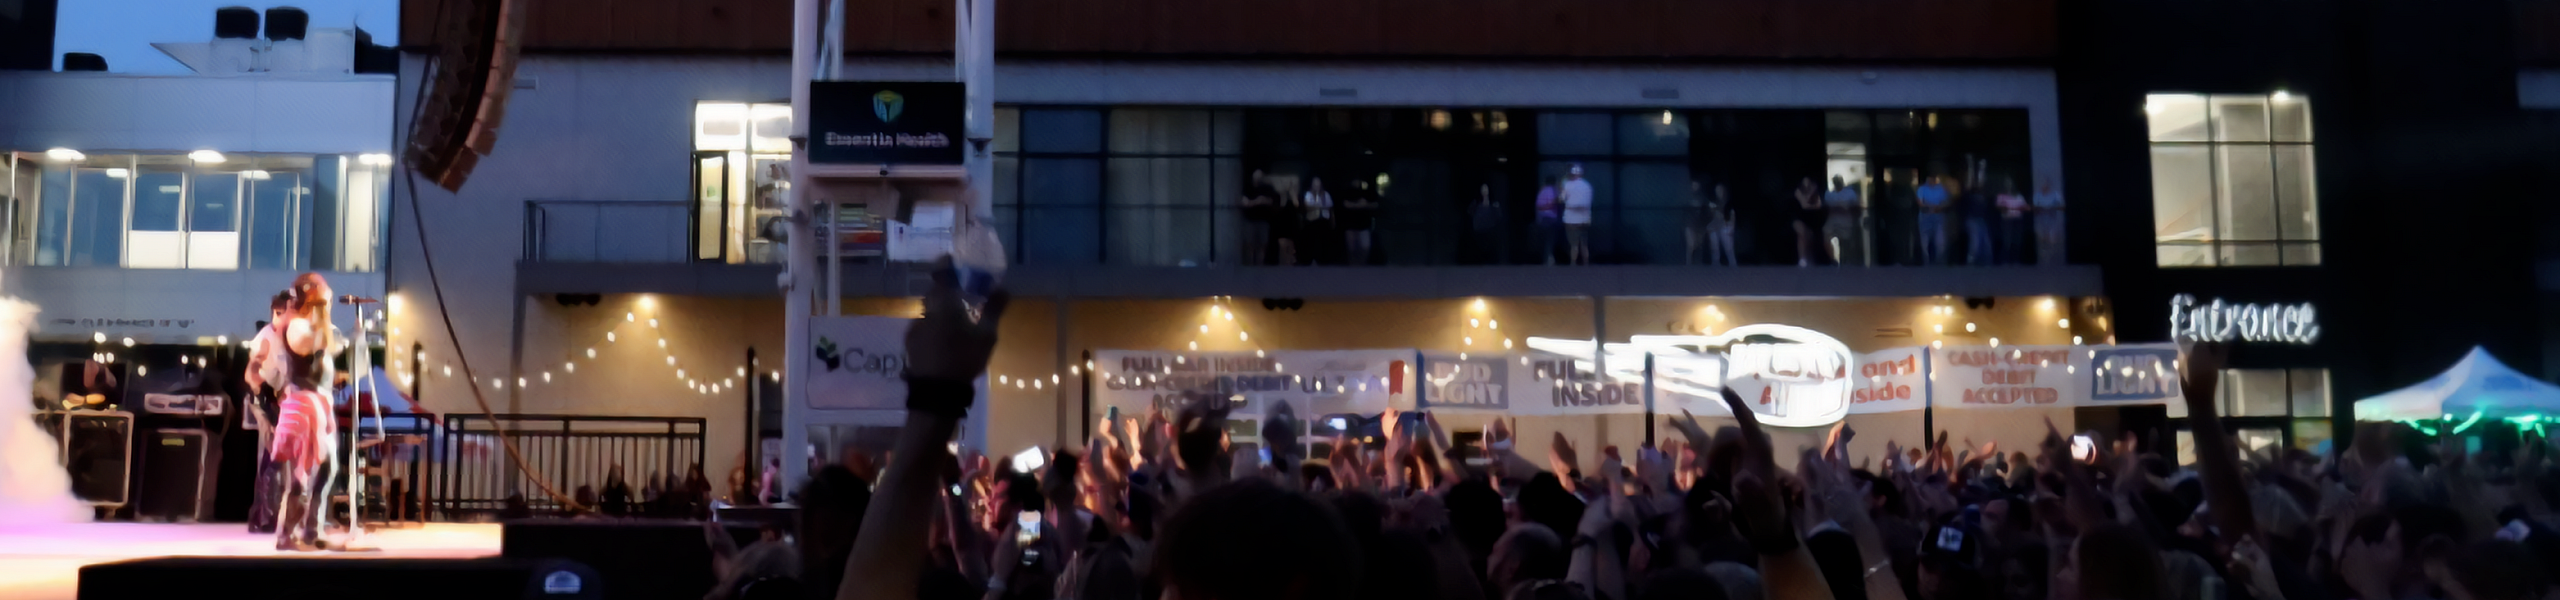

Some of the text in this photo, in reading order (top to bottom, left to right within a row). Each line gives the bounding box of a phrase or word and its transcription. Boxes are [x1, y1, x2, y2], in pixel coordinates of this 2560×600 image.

[2169, 293, 2320, 344] Entrance
[1433, 361, 1492, 382] BUD
[1425, 381, 1502, 404] LIGHT
[1552, 382, 1640, 407] INSIDE
